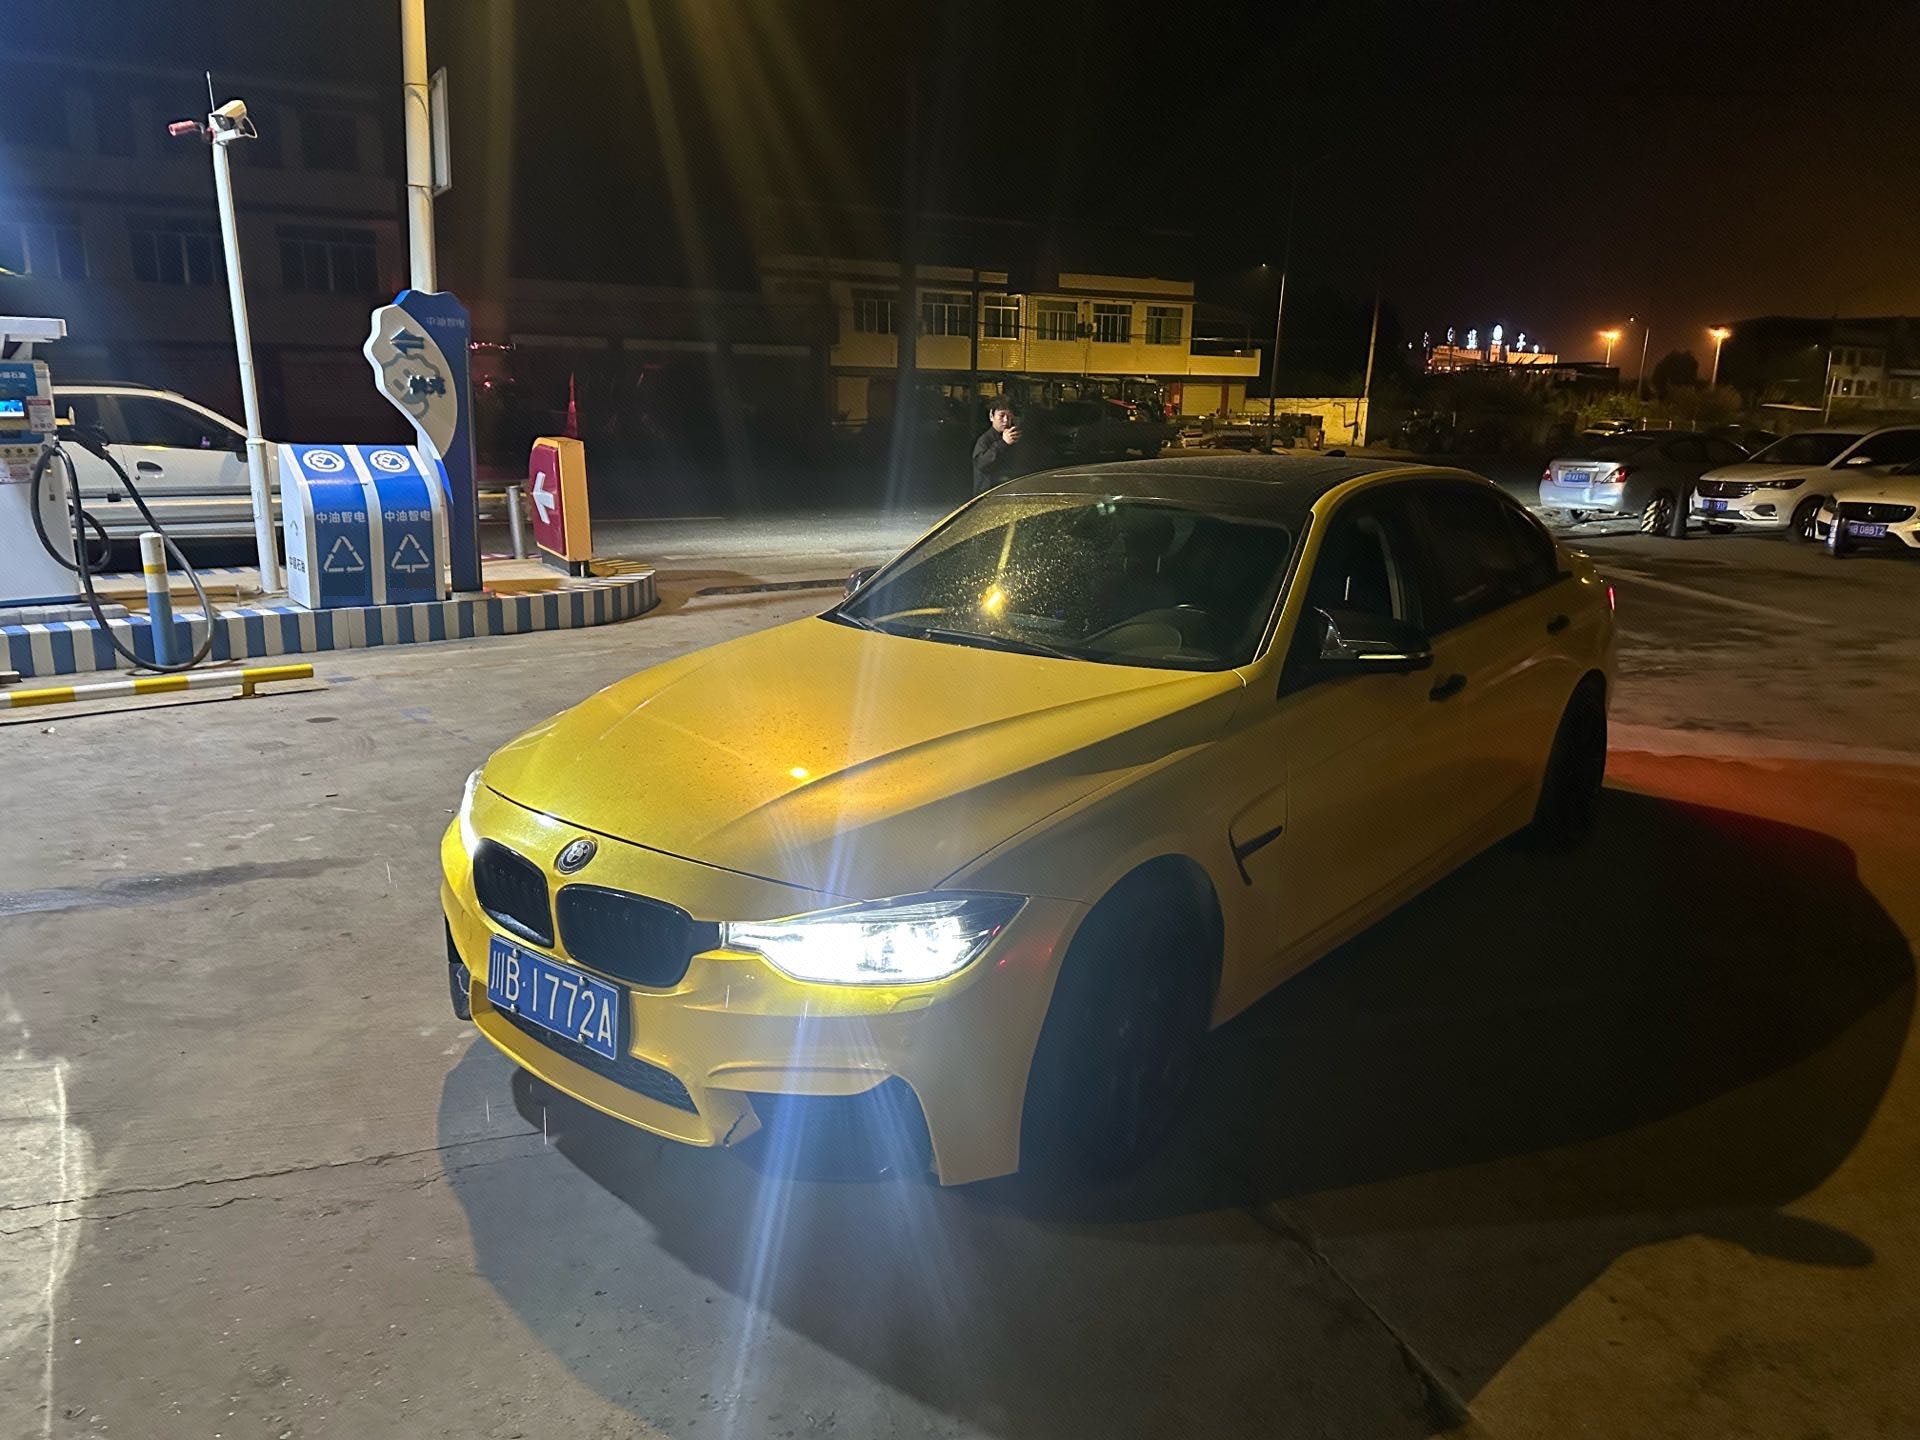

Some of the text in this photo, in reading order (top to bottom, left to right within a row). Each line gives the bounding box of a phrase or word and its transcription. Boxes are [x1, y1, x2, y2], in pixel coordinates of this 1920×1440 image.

[316, 511, 367, 524] 中油智电
[384, 510, 432, 522] 中油智电
